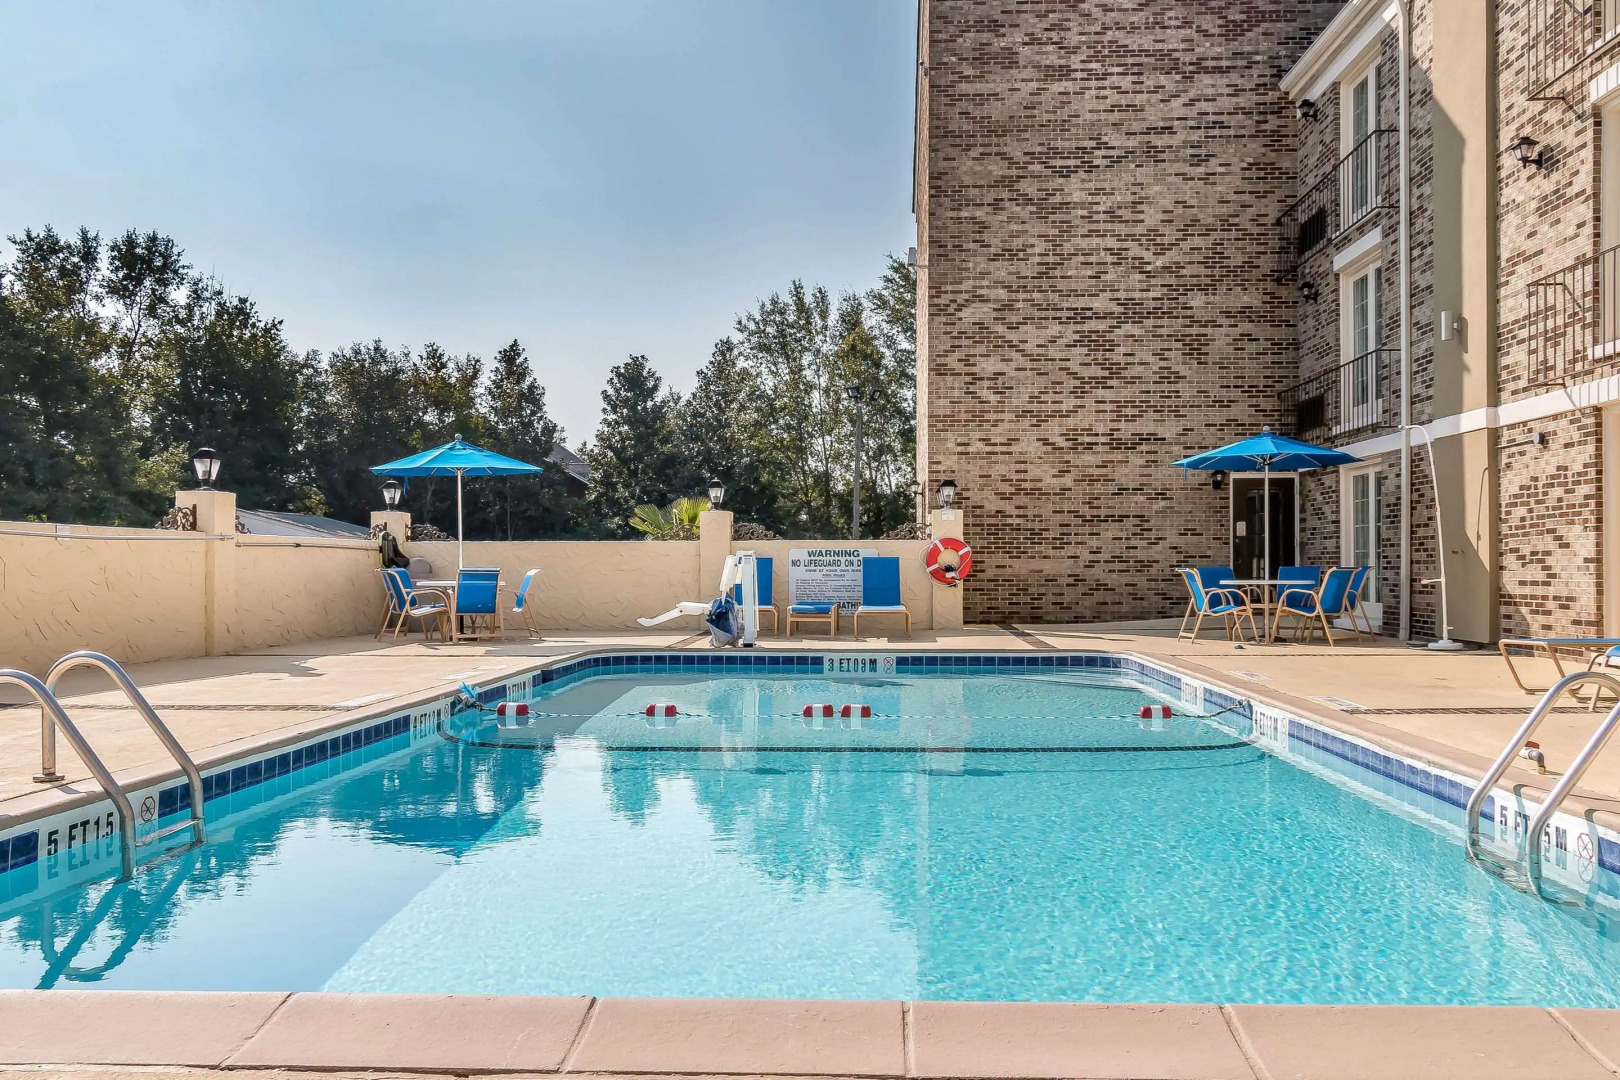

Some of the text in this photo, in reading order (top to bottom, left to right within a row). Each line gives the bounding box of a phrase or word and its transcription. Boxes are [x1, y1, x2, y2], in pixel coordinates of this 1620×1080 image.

[791, 559, 801, 568] NO
[803, 559, 841, 568] LIFEGUARD
[844, 559, 855, 568] ON
[807, 549, 860, 558] WARNING
[47, 829, 59, 856] 5
[68, 819, 91, 850] FT
[1500, 804, 1508, 827] 5
[1514, 810, 1531, 835] FT
[1555, 825, 1567, 852] M
